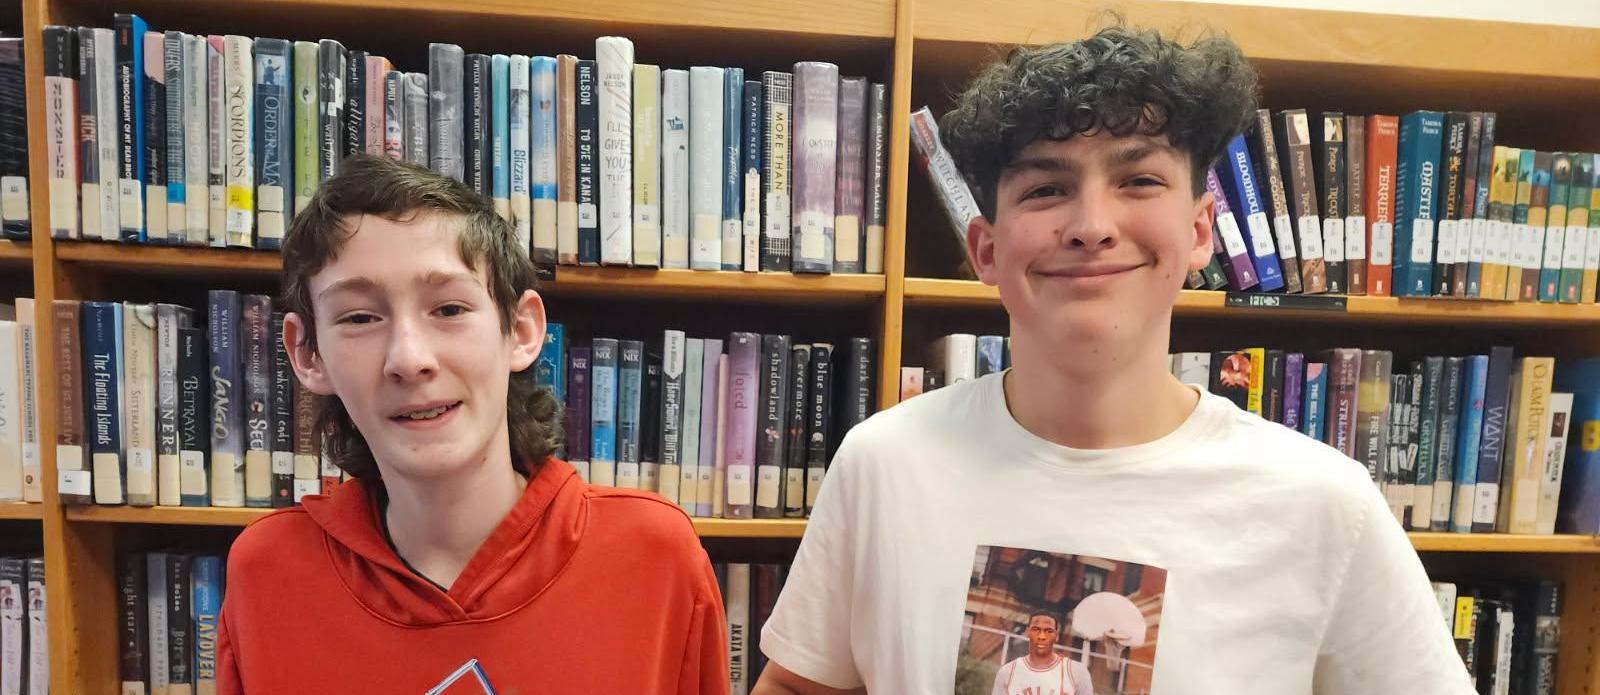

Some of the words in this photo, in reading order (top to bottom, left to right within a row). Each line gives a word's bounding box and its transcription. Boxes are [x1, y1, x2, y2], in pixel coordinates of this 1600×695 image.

[166, 39, 181, 71] MYERS
[473, 60, 481, 84] PHYLLIS
[580, 66, 591, 105] NELSON
[123, 66, 131, 121] AUTOBIOGRAPHY
[388, 79, 396, 101] NAPOLI
[473, 86, 481, 116] REYNOLDS
[81, 115, 96, 143] KICK
[230, 86, 246, 178] SCORPIONS
[264, 97, 281, 149] ORDER
[580, 128, 591, 141] TO
[774, 112, 785, 149] MORE
[1262, 116, 1274, 153] PIERCE
[124, 134, 131, 143] MY
[580, 144, 591, 160] DIE
[604, 138, 625, 151] GIVE
[875, 124, 884, 180] MONSTER
[473, 149, 481, 170] GOING
[513, 149, 527, 193] Blizzard
[580, 163, 591, 174] IN
[606, 156, 626, 169] YOU
[774, 154, 785, 191] THAN
[1377, 166, 1391, 223] TERRIER
[252, 305, 260, 340] WILLIAM
[94, 353, 110, 370] The
[252, 344, 261, 394] NICHOLSON
[595, 351, 611, 360] NIX
[623, 353, 640, 362] NIX
[859, 356, 870, 382] dark
[276, 371, 287, 402] where
[768, 352, 781, 420] shadowland
[816, 362, 828, 389] blue
[94, 372, 111, 410] Floating
[665, 382, 679, 403] Have
[795, 363, 805, 421] evermore
[858, 387, 870, 419] flame
[1311, 383, 1319, 400] THE
[162, 368, 175, 445] RUNNER
[182, 376, 198, 450] BETRAYAL
[664, 404, 679, 431] Sword,
[815, 395, 825, 427] moon
[1310, 401, 1318, 420] BELL
[96, 413, 112, 445] Islands
[277, 420, 288, 442] ends
[1369, 415, 1380, 435] FIRE
[1483, 406, 1505, 462] WANT
[1368, 437, 1379, 458] WILL
[127, 611, 136, 633] star
[198, 614, 215, 680] LAYOVER
[731, 624, 743, 652] AKATA
[730, 655, 742, 684] WITCH
